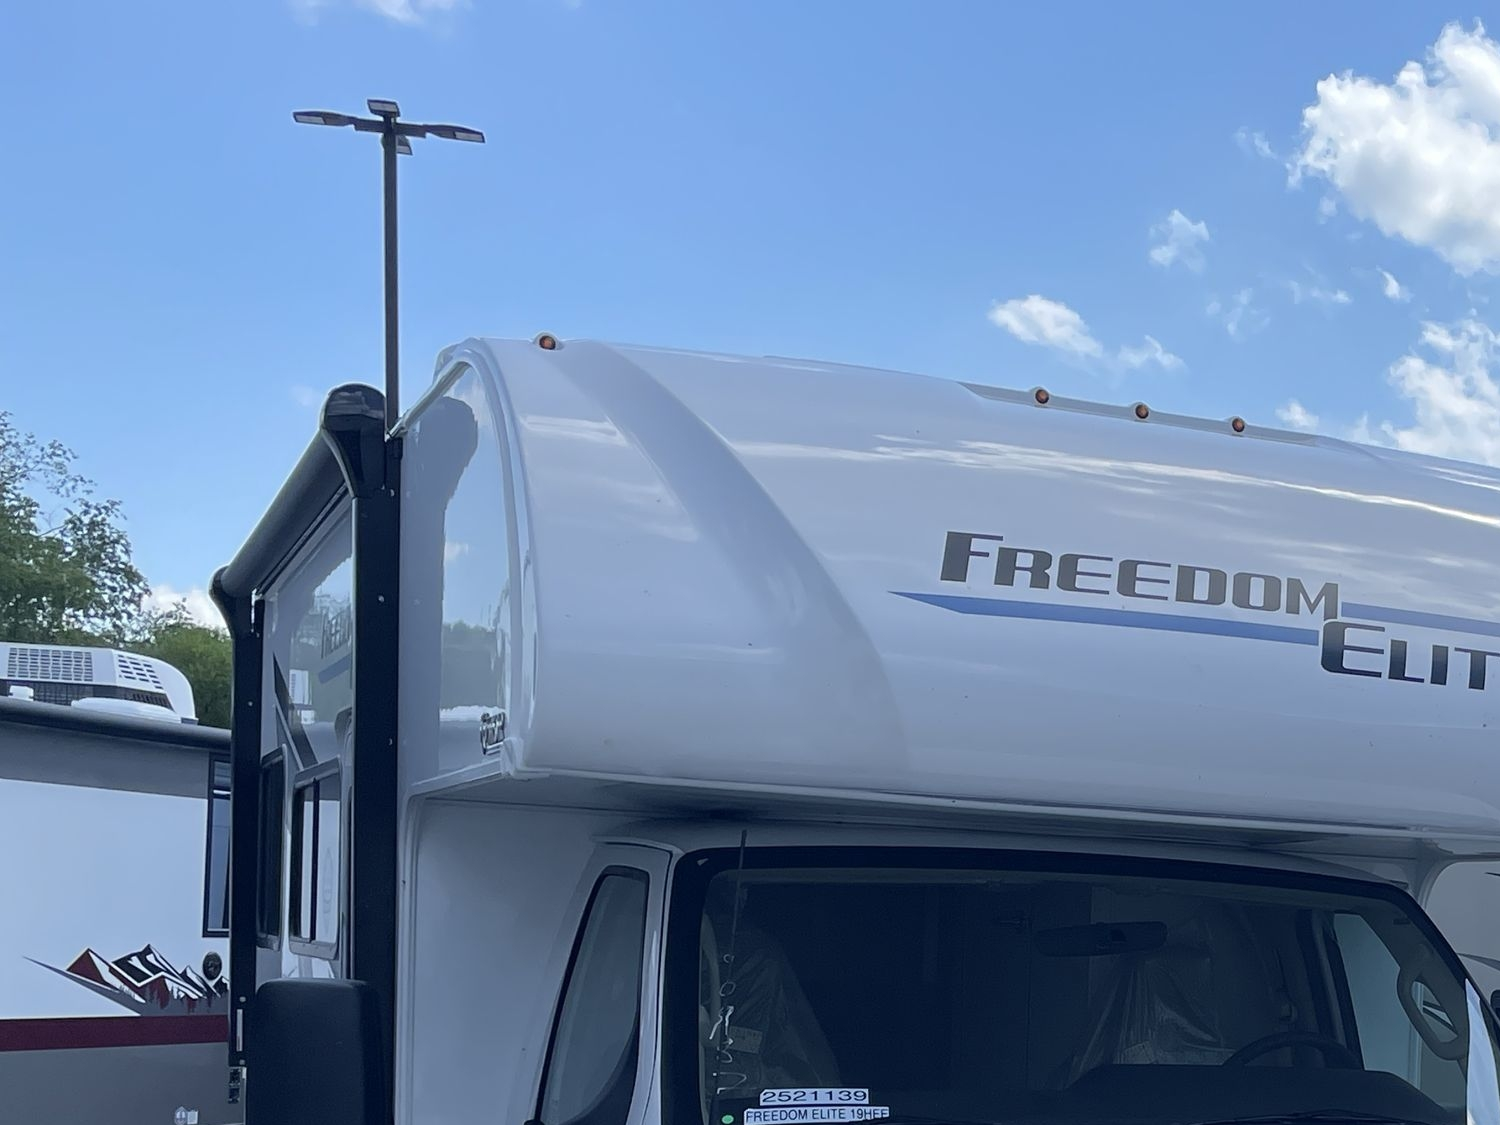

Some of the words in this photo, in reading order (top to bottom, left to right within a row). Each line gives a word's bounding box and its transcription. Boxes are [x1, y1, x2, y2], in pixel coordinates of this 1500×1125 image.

[939, 530, 1339, 622] FREEDOM
[761, 1090, 867, 1103] 2521139
[745, 1109, 808, 1123] FREEDOM
[811, 1108, 846, 1120] ELITE
